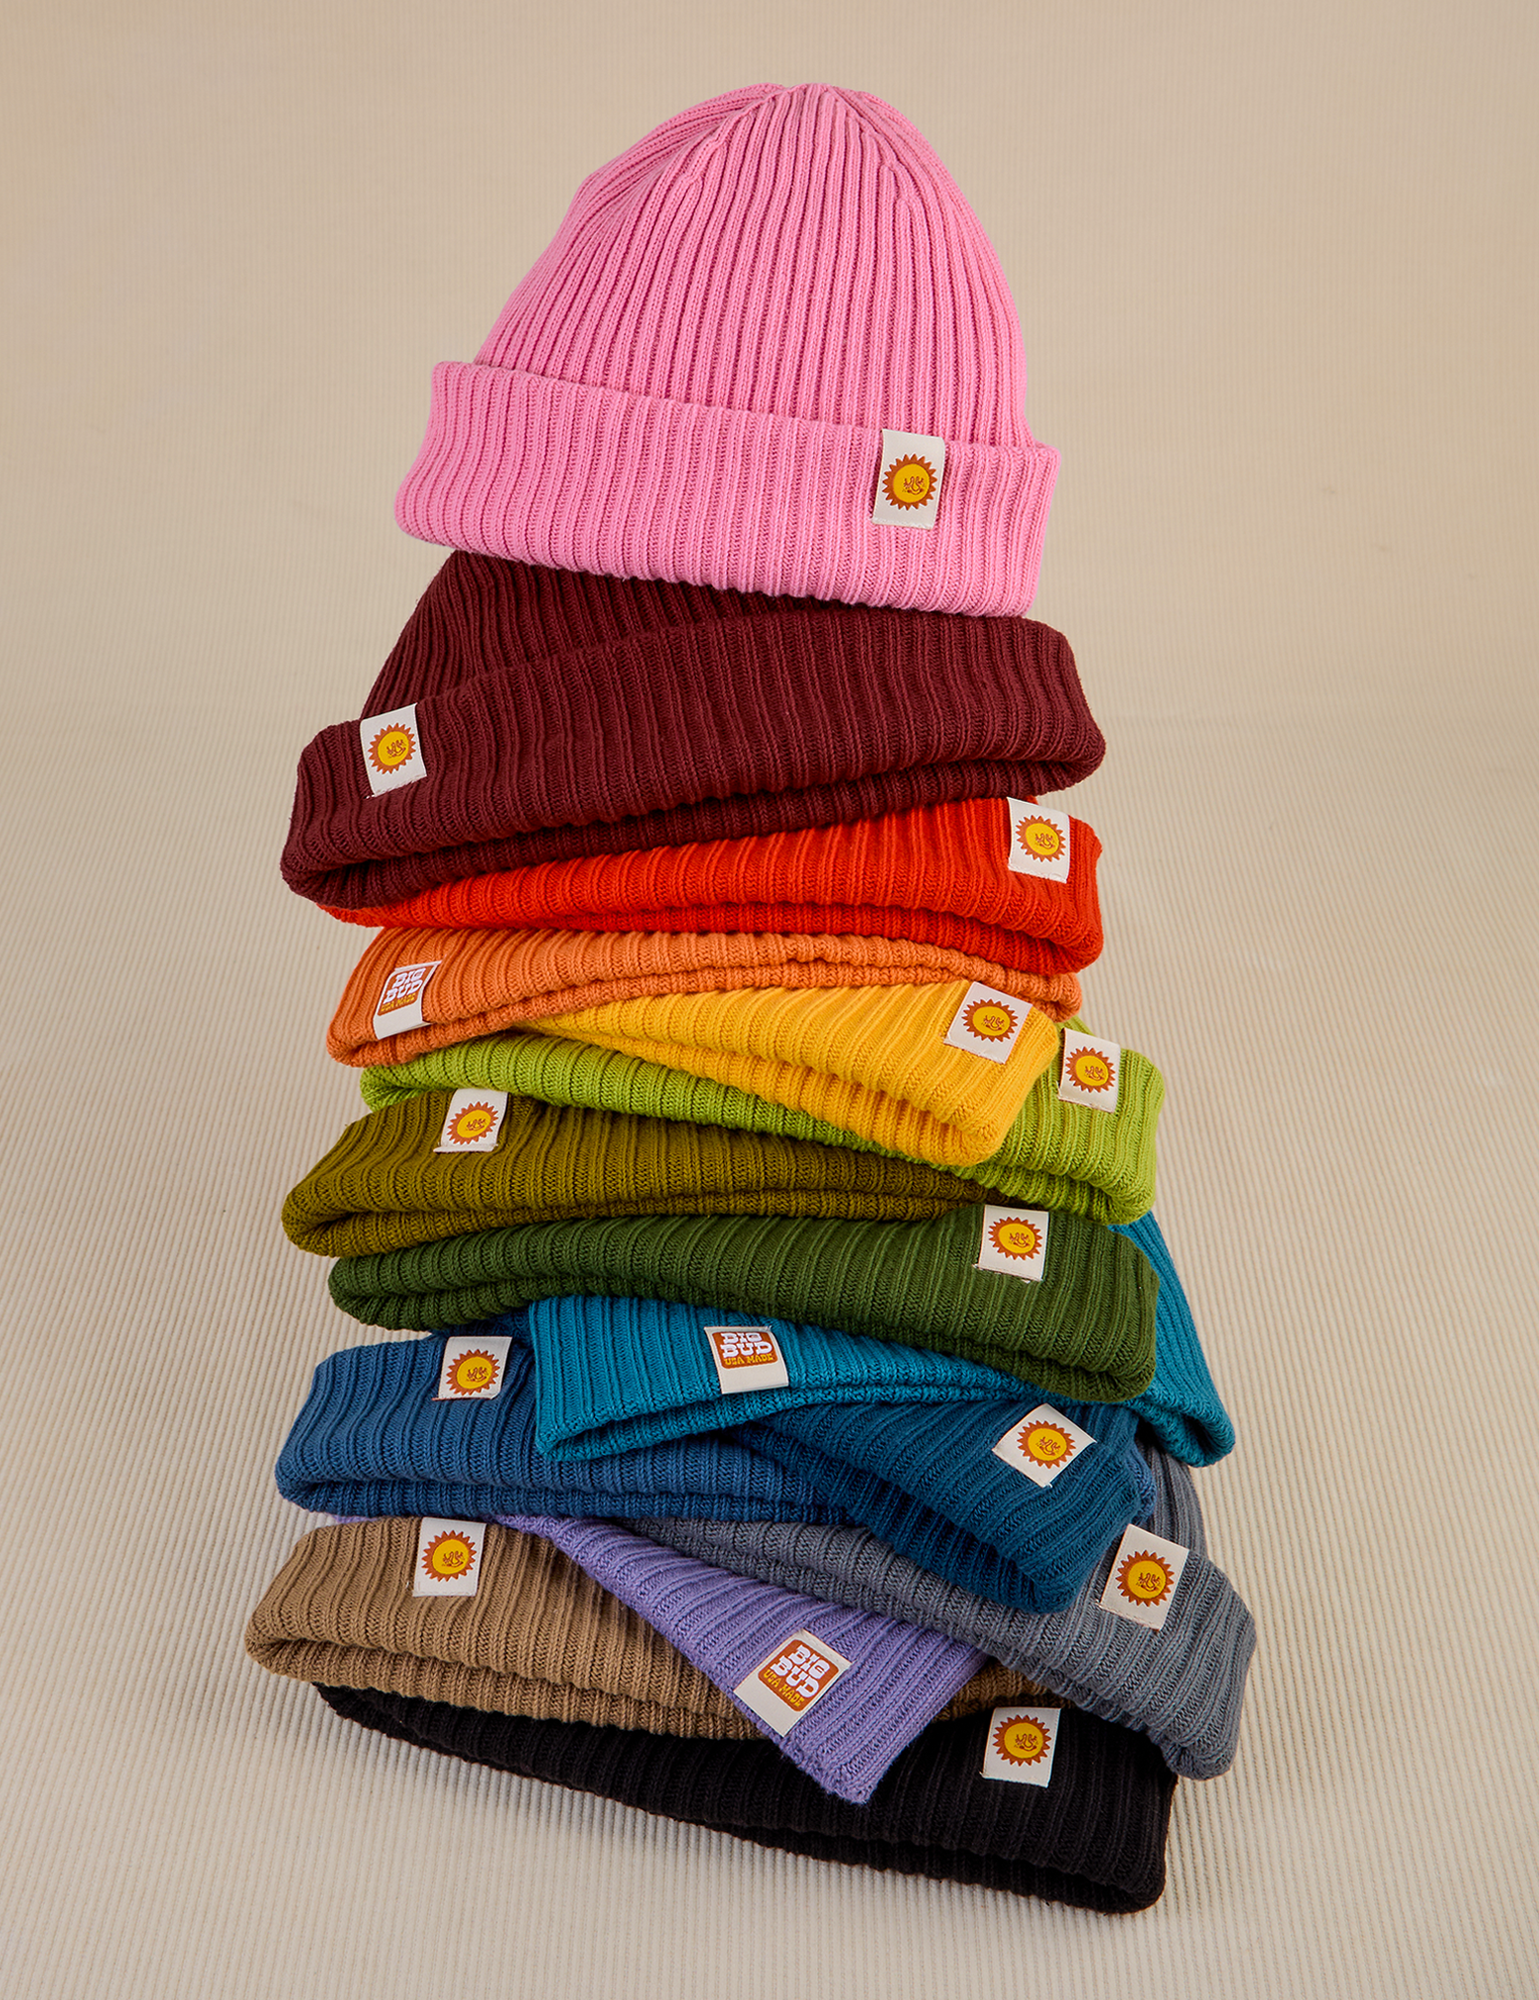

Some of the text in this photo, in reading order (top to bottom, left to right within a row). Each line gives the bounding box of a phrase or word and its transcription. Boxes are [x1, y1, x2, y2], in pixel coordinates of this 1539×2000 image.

[720, 1332, 762, 1344] BIG
[720, 1341, 773, 1358] BUD
[746, 1353, 774, 1364] MADE
[788, 1644, 830, 1679] BIG
[770, 1655, 820, 1698] BUD
[779, 1684, 806, 1707] MADE
